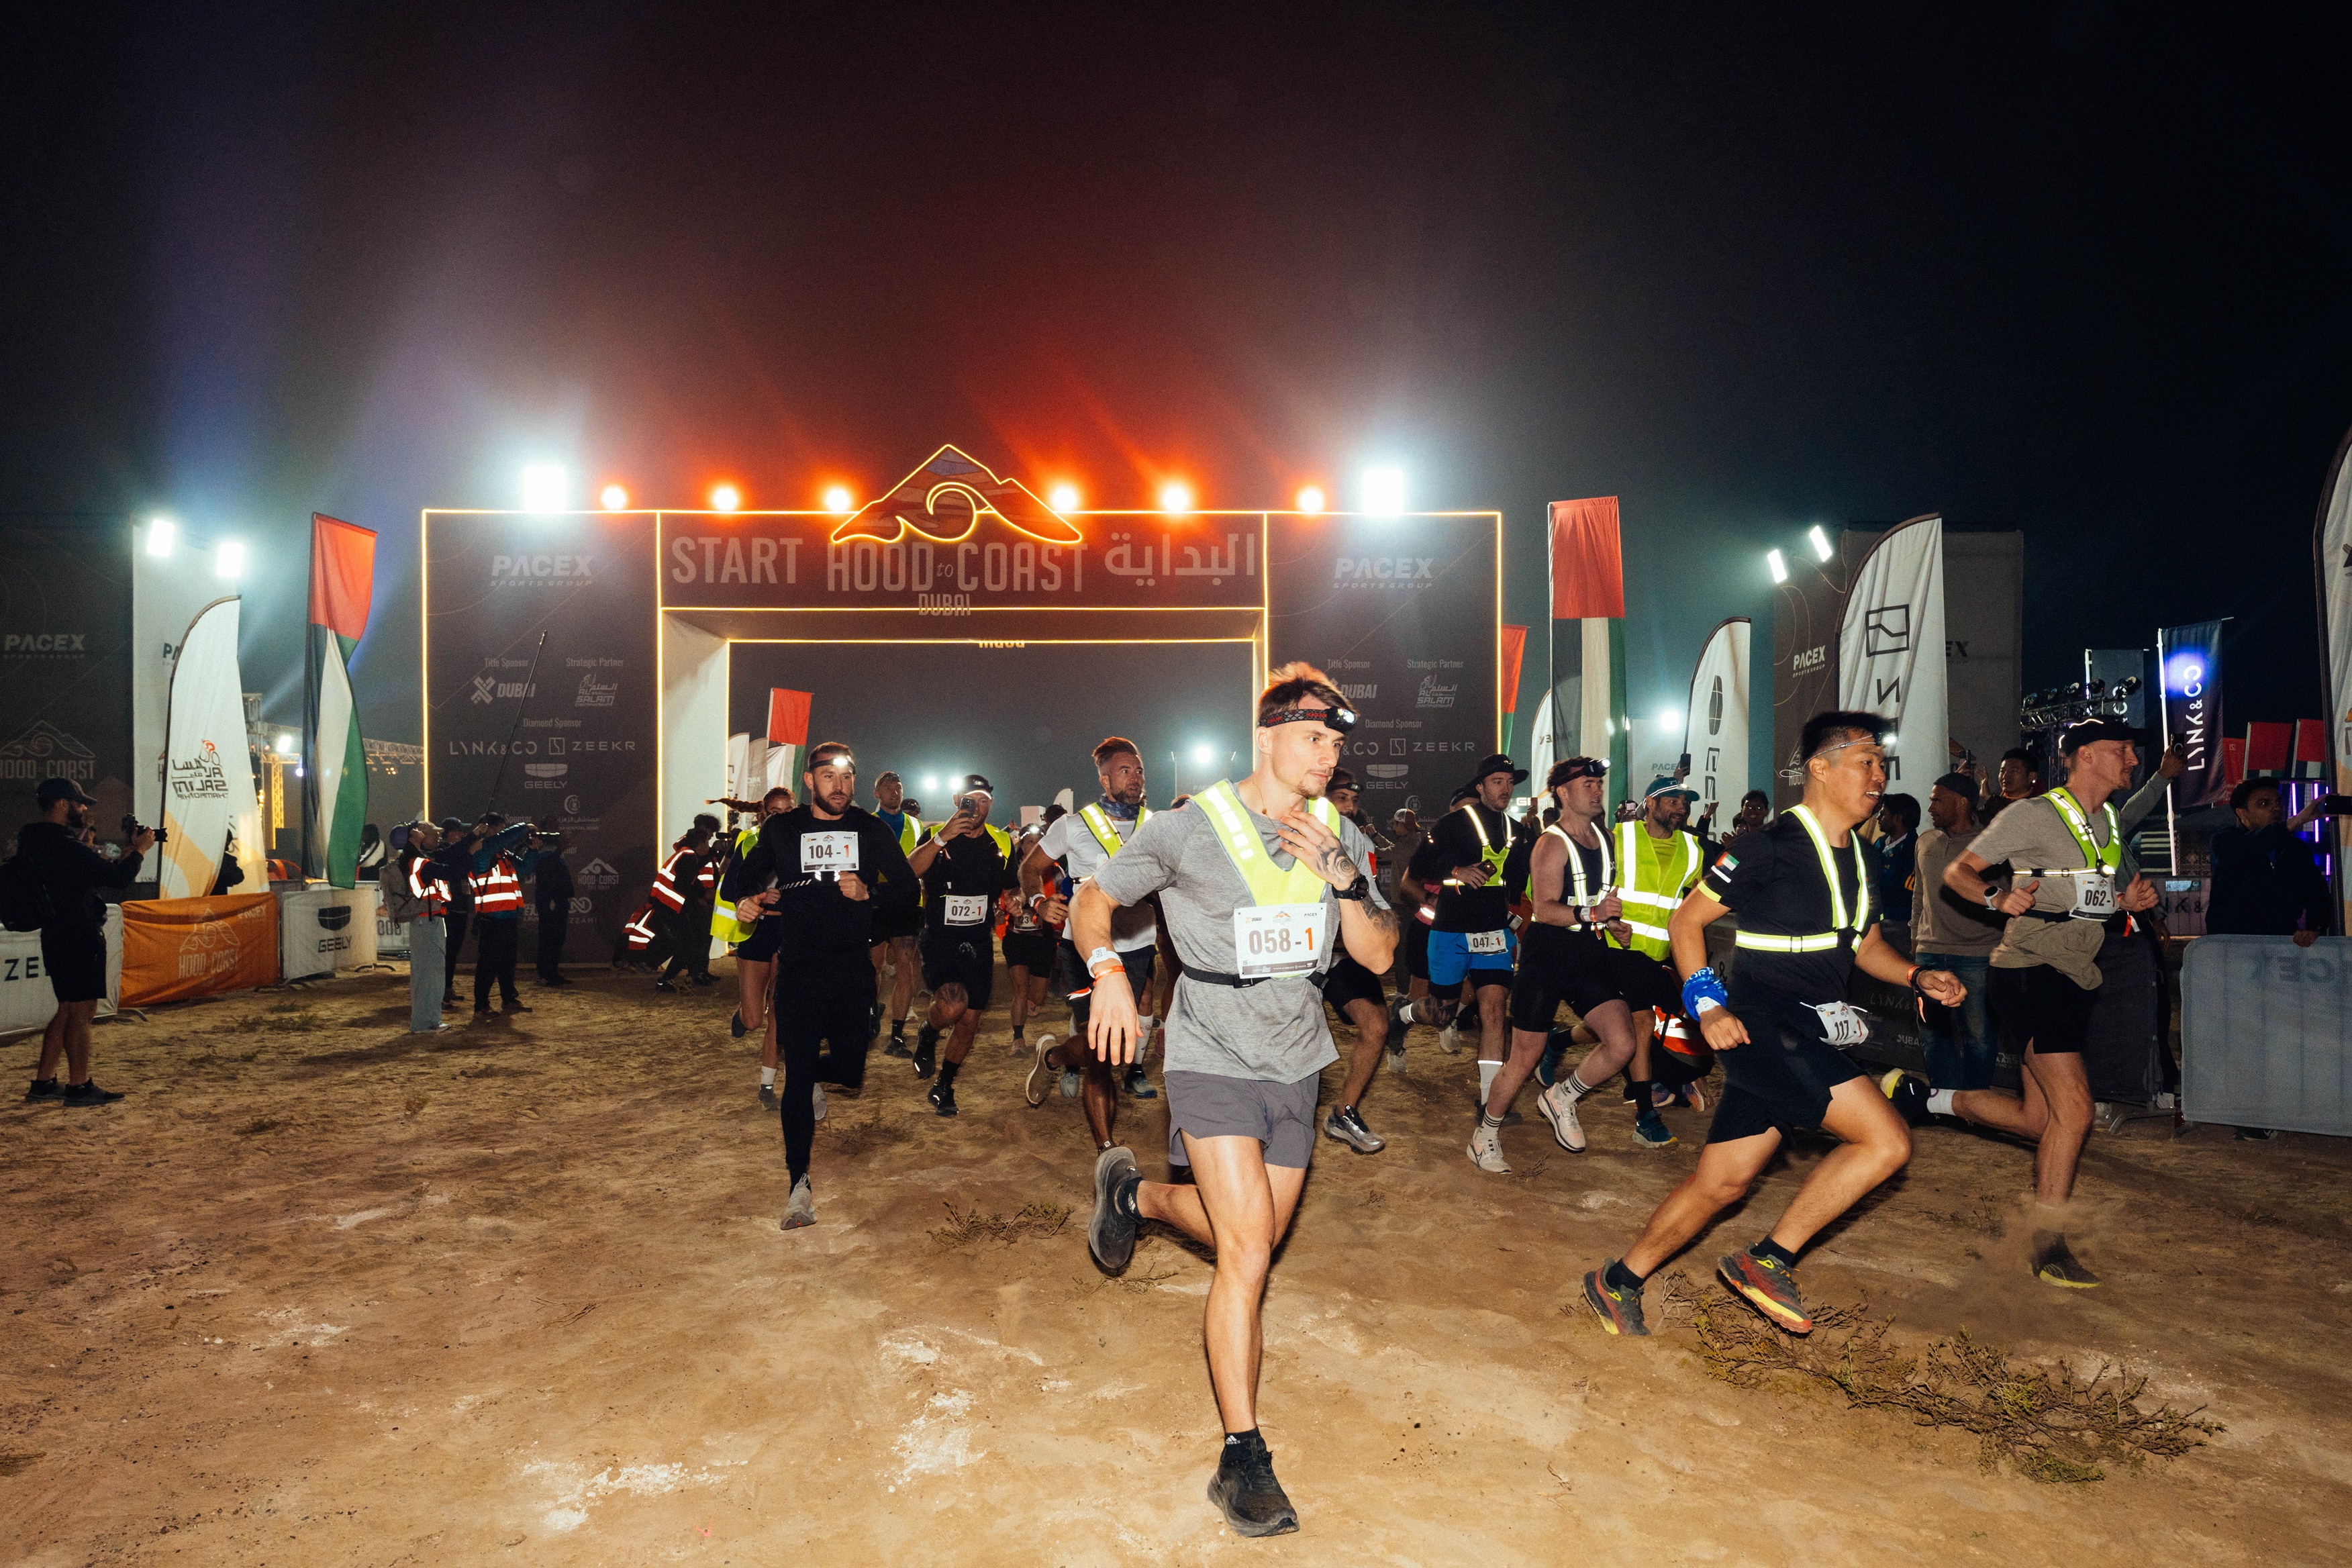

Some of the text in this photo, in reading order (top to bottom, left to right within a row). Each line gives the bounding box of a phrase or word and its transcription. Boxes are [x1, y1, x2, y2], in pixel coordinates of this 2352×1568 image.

[491, 554, 595, 577] PACEX
[672, 537, 803, 584] START
[827, 542, 1089, 591] HOOD to COAST
[1104, 532, 1255, 587] البداية
[1334, 557, 1434, 579] PACEX
[918, 593, 971, 616] DUBAI
[5, 634, 86, 651] PACEX
[485, 658, 529, 668] Title Sponsor
[566, 658, 624, 668] Strategic Partner
[1327, 659, 1371, 670] Title Sponsor
[1408, 659, 1464, 670] Strategic Partner
[1793, 645, 1826, 671] PACEX
[497, 683, 536, 697] DUBAI
[1340, 684, 1377, 699] DUBAI
[1416, 697, 1455, 705] SALAM
[523, 718, 582, 729] Diamond Sponsor
[1365, 720, 1422, 730] Diamond Sponsor
[572, 740, 636, 752] ZEEKR
[1413, 741, 1475, 752] ZEEKR
[46, 760, 95, 779] COAST
[524, 781, 568, 789] GEELY
[1366, 781, 1409, 789] GEELY
[578, 875, 620, 885] HOOD COAST
[318, 936, 352, 953] GEELY
[179, 952, 206, 979] HOOD
